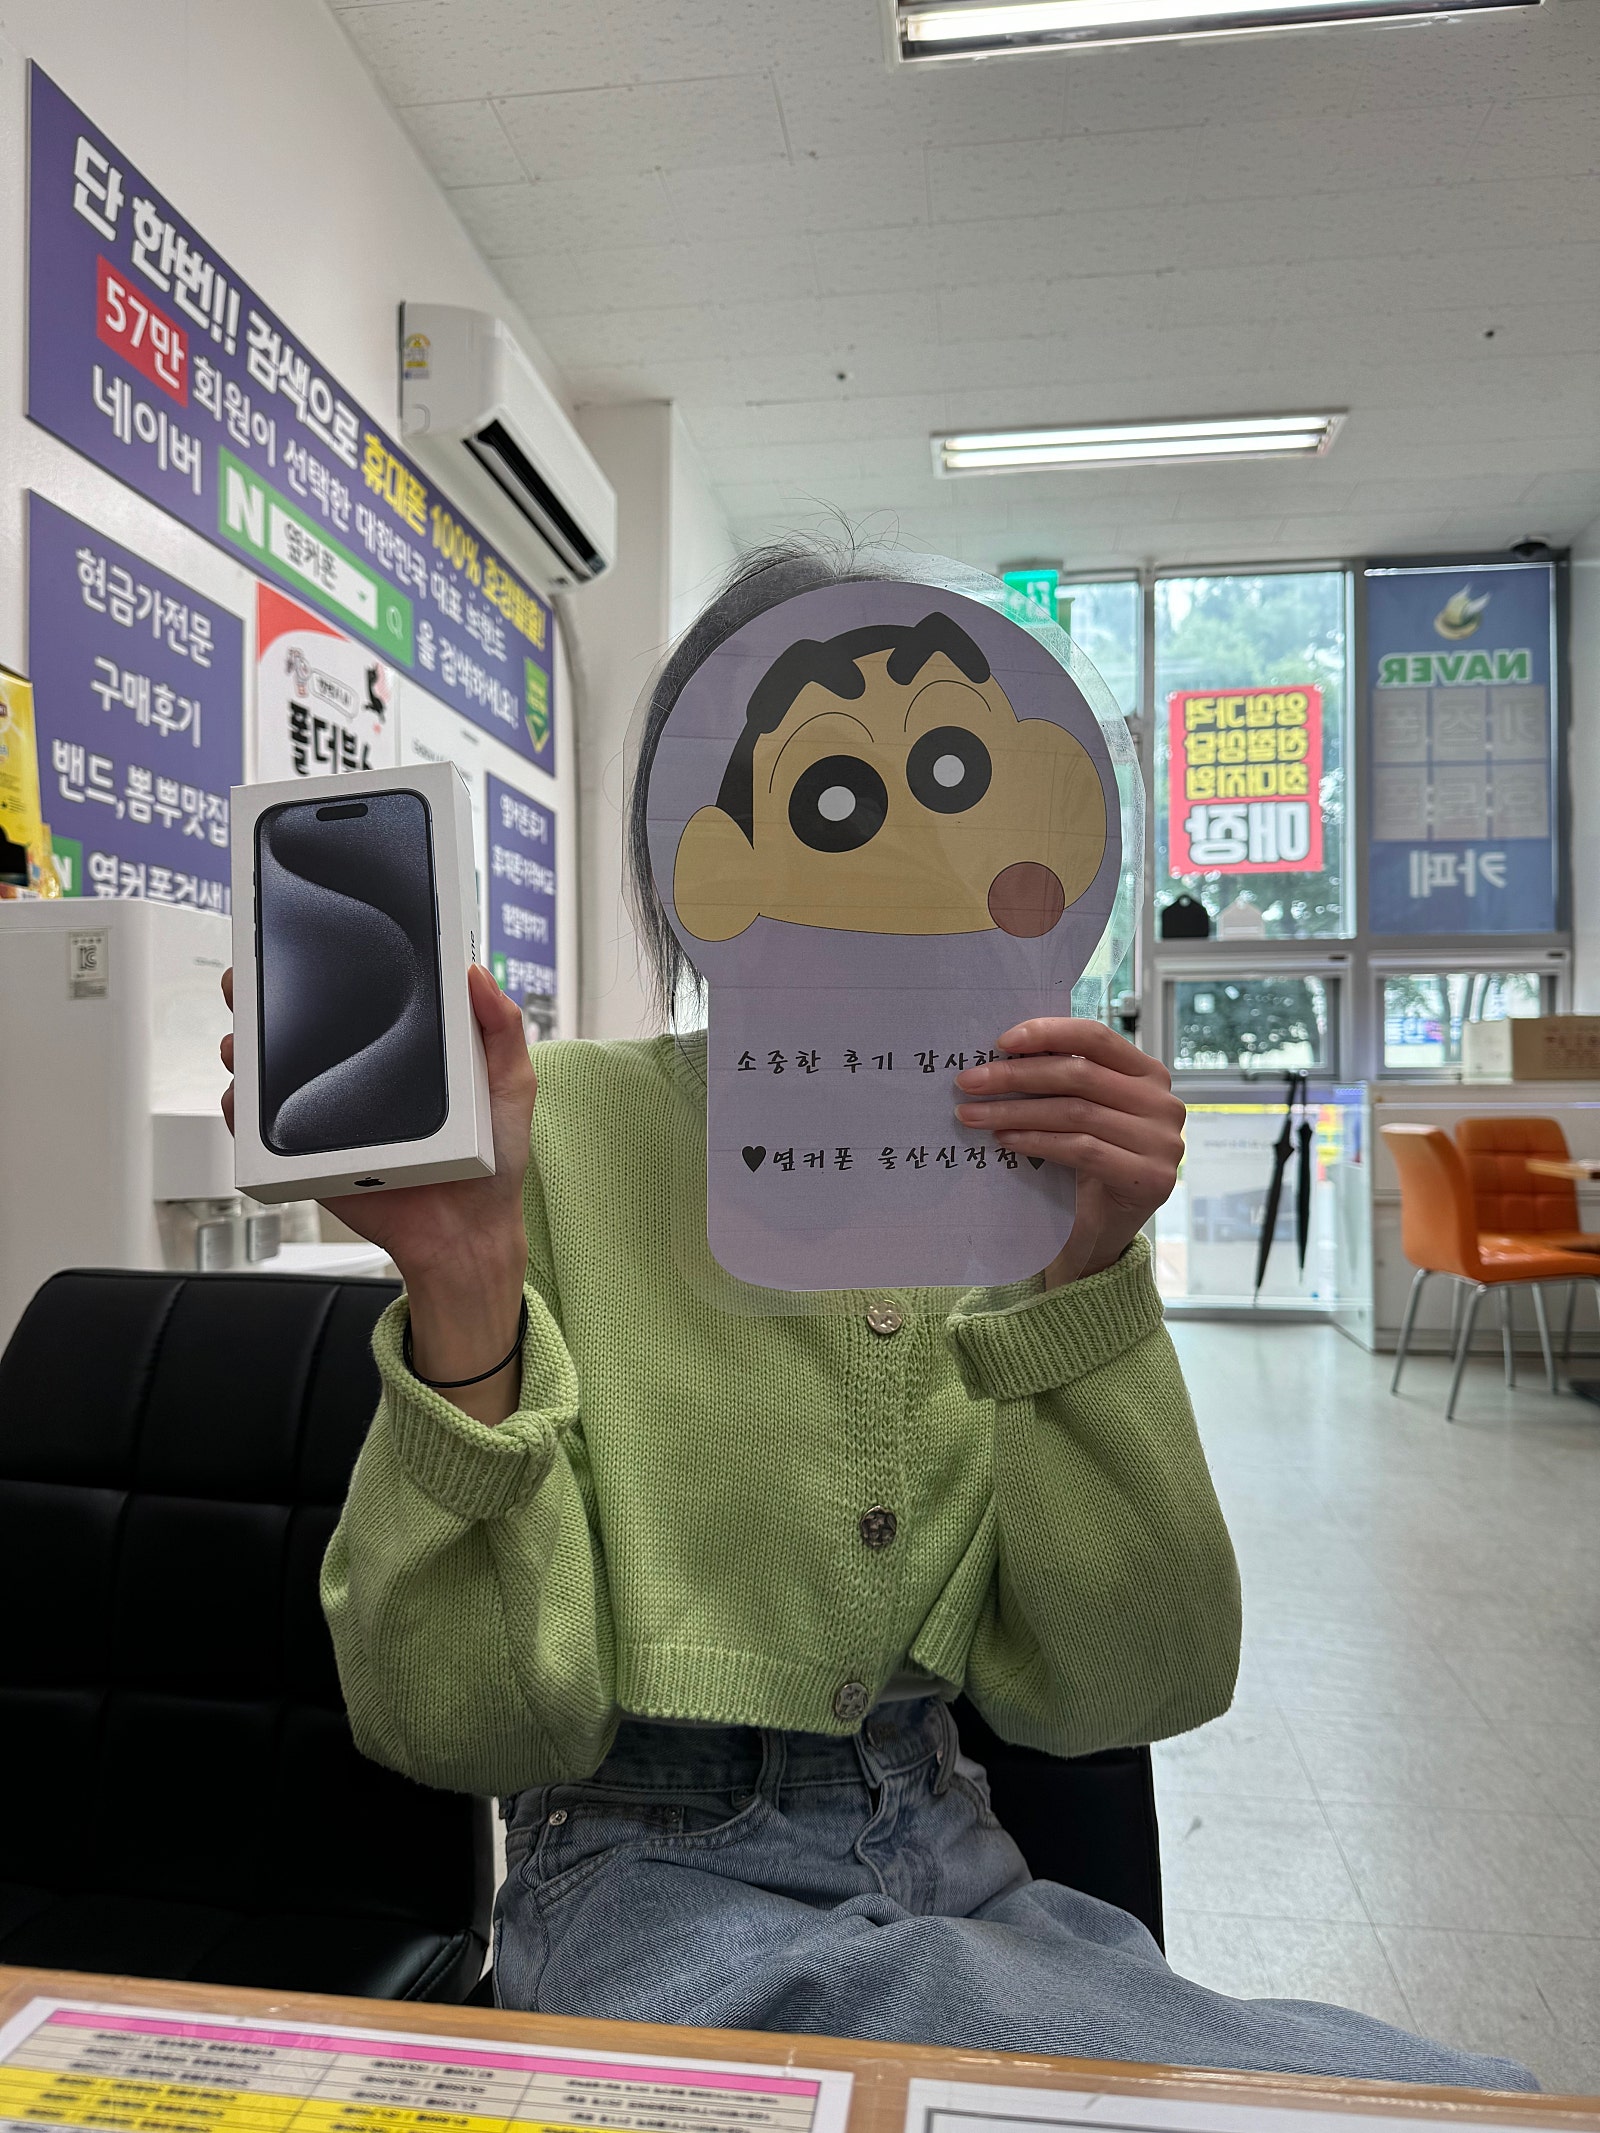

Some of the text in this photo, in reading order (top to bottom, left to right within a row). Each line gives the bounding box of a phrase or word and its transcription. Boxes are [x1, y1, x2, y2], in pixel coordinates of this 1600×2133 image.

[73, 137, 124, 240] 단
[132, 198, 240, 354] 한번!!
[246, 310, 360, 468] 검색으로
[361, 432, 427, 537] 휴대폰
[431, 505, 481, 587] 100%
[105, 276, 184, 388] 57만
[193, 357, 276, 466] 회원이
[284, 439, 351, 532] 선택한
[355, 504, 428, 599] 대한민국
[93, 366, 202, 494] 네이버
[226, 467, 264, 548] N
[417, 619, 436, 671] 을
[76, 547, 214, 668] 현금가전문
[91, 658, 201, 748] 구매후기
[737, 1050, 821, 1074] 소중한
[843, 1049, 894, 1074] 후기
[773, 1145, 1018, 1172] 옆커폰 울산신정점
